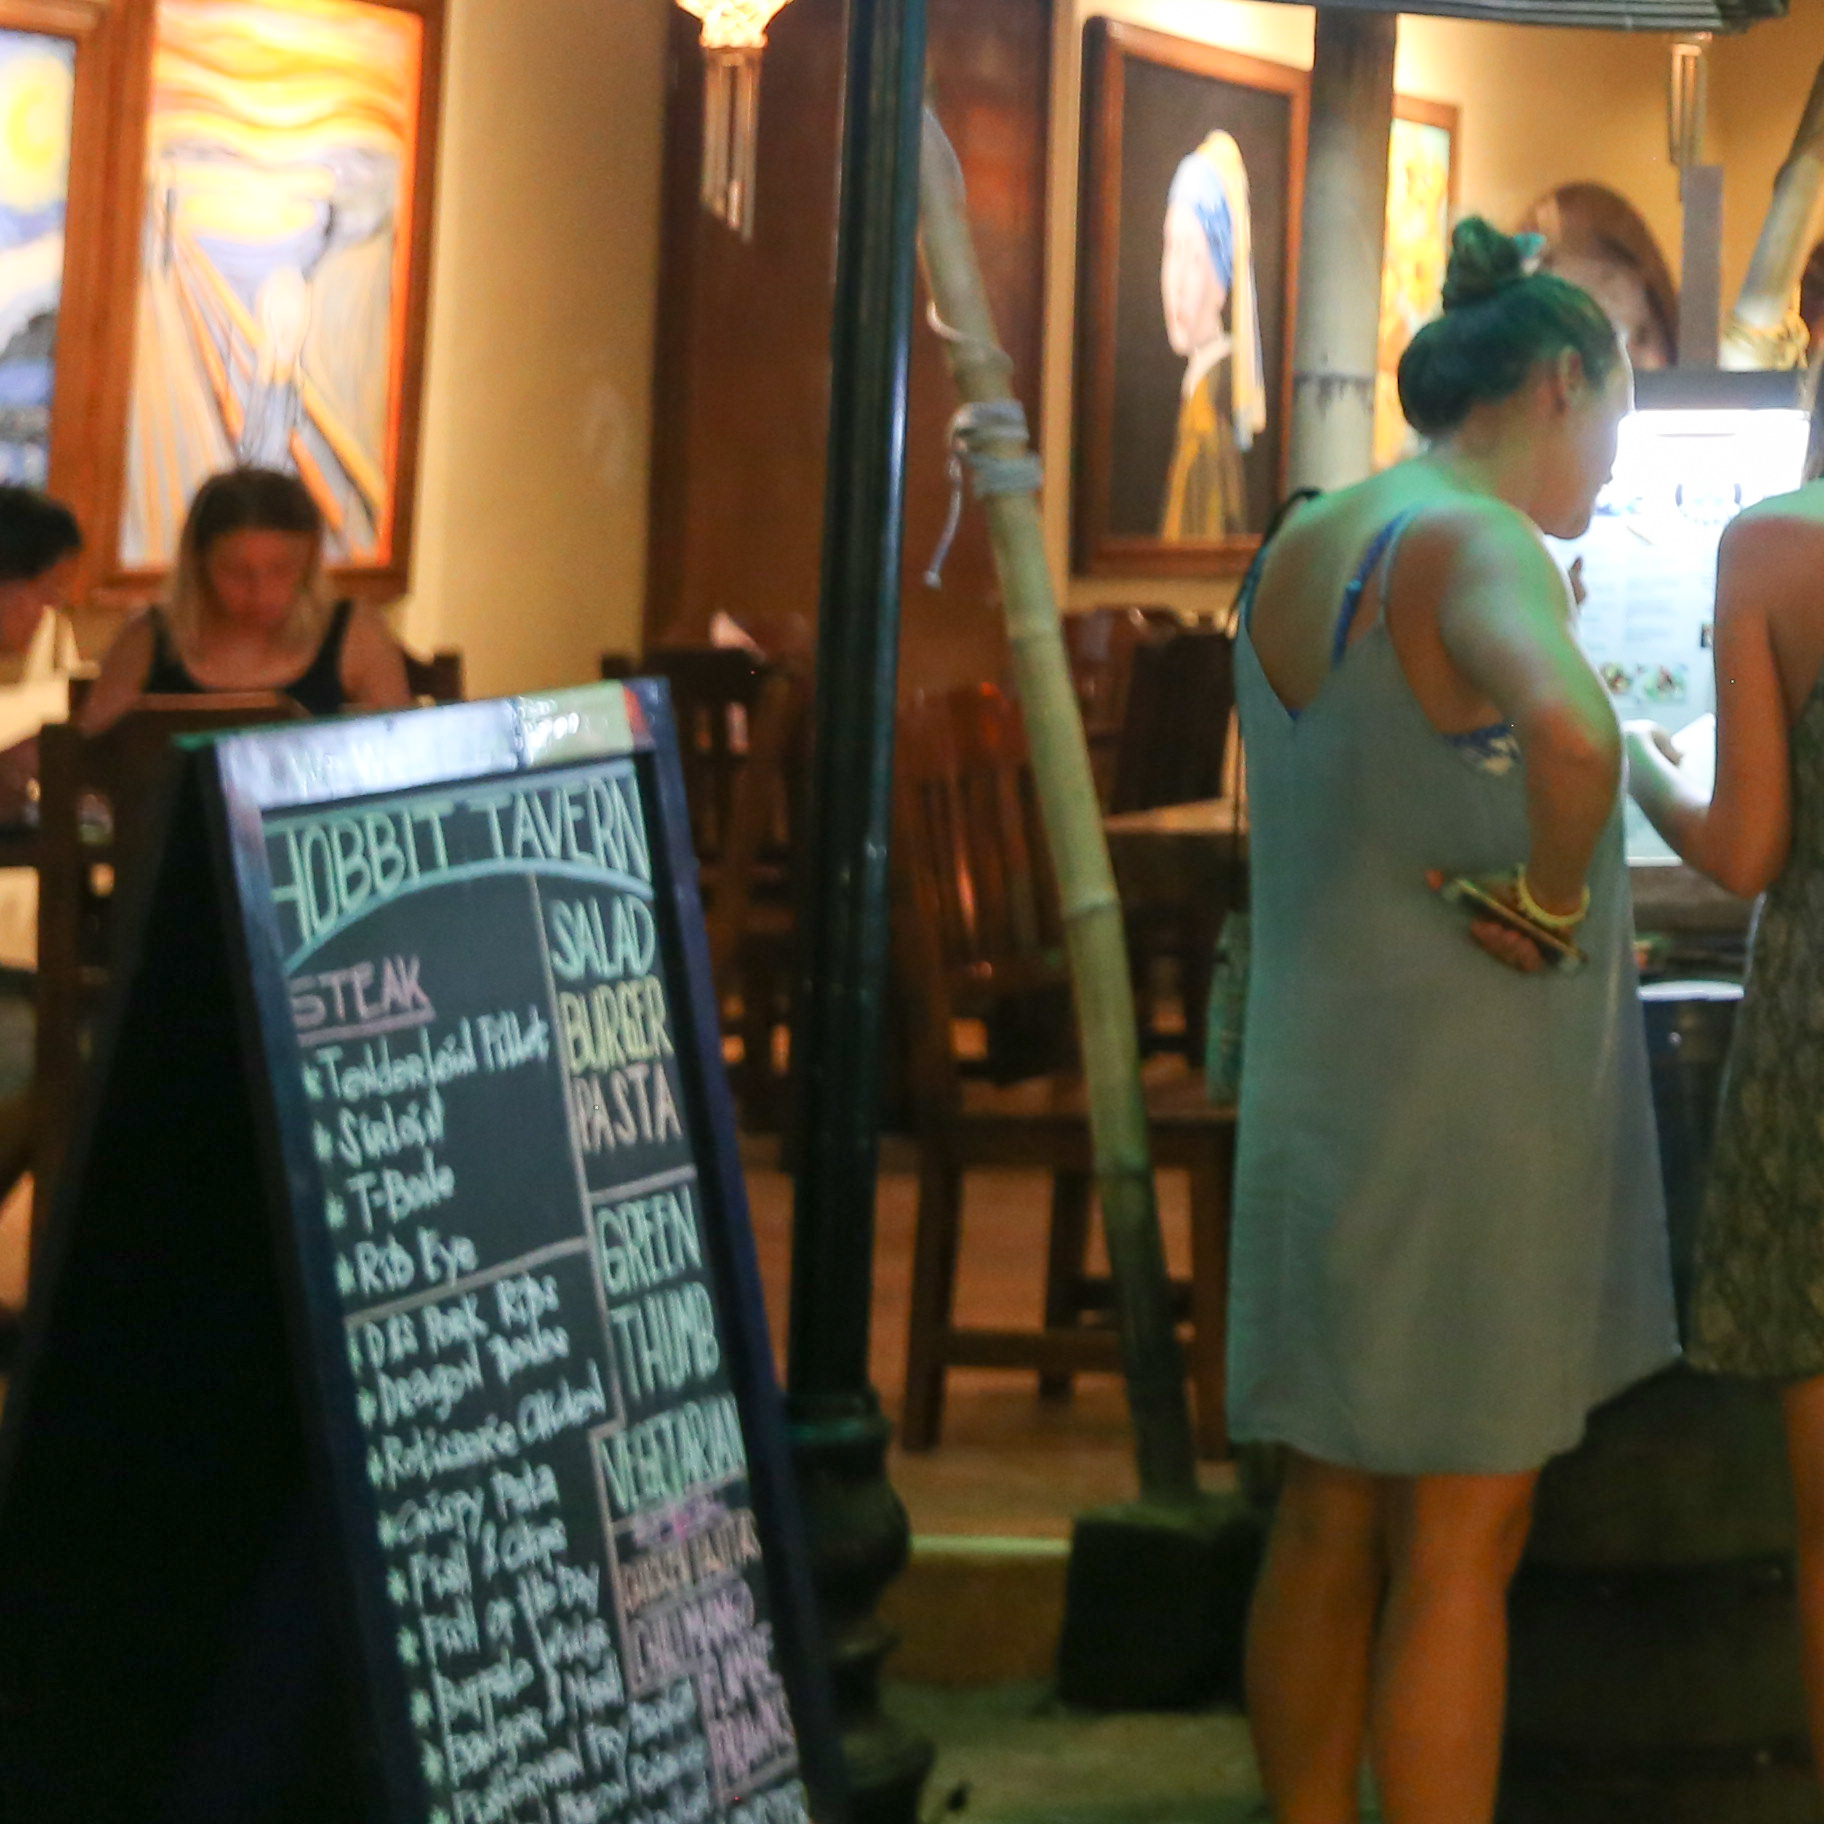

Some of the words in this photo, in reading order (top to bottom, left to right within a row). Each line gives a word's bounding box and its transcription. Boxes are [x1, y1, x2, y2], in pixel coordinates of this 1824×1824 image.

[268, 800, 454, 946] HOBBIT
[466, 774, 652, 882] TAVERN
[551, 894, 655, 981] SALAD
[289, 953, 432, 1026] STEAK
[558, 974, 675, 1076] BURGER
[573, 1061, 683, 1155] PASTA
[355, 1233, 416, 1298] Rib
[595, 1184, 702, 1296] GREEN
[609, 1281, 721, 1403] THUMB
